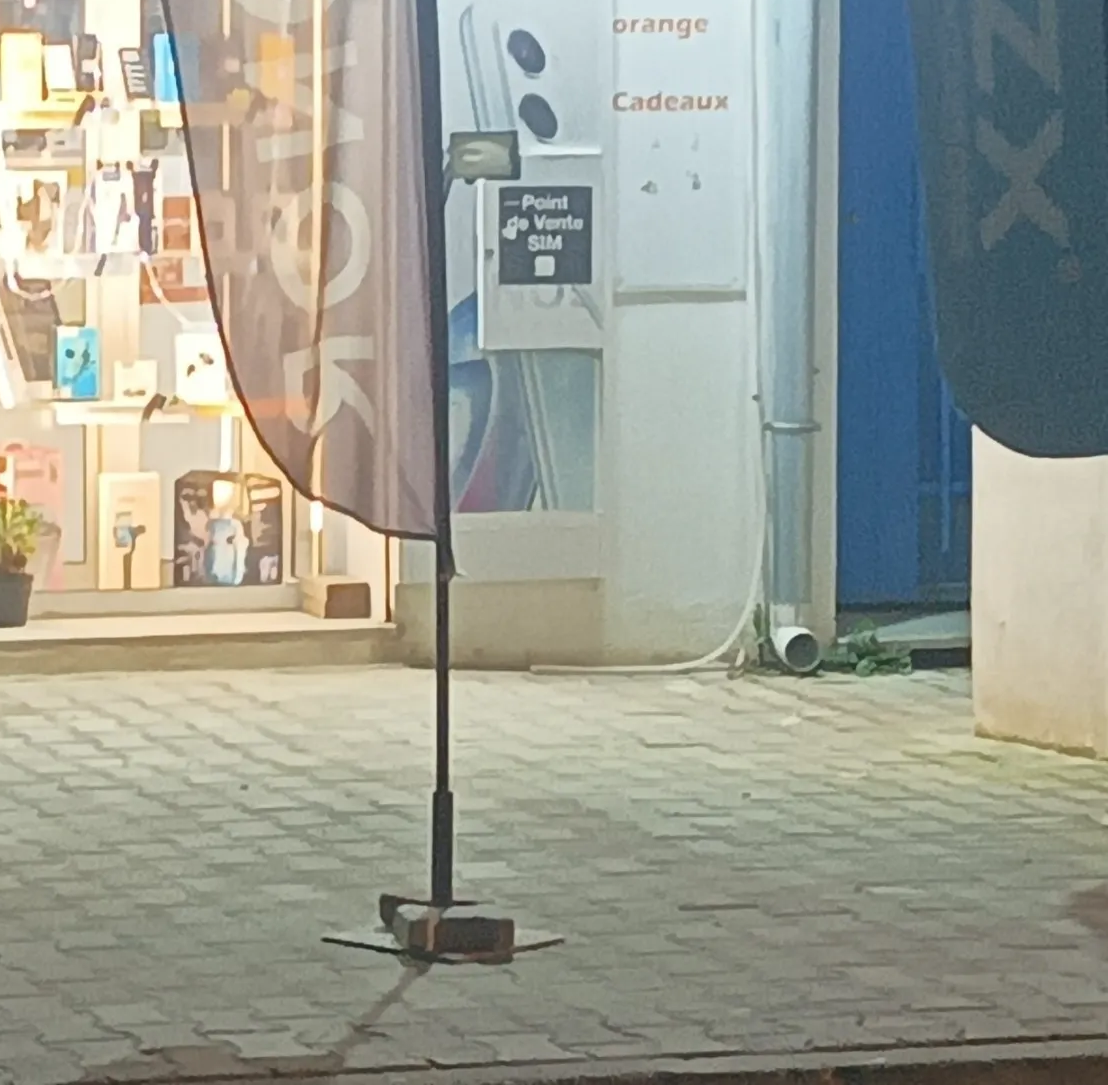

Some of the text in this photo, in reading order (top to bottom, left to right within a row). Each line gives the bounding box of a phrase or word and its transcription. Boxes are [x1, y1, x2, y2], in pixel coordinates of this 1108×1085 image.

[612, 17, 709, 40] orange
[612, 91, 729, 113] Cadeaux
[521, 194, 569, 211] Point
[534, 214, 584, 232] Vente
[527, 234, 563, 252] SIM
